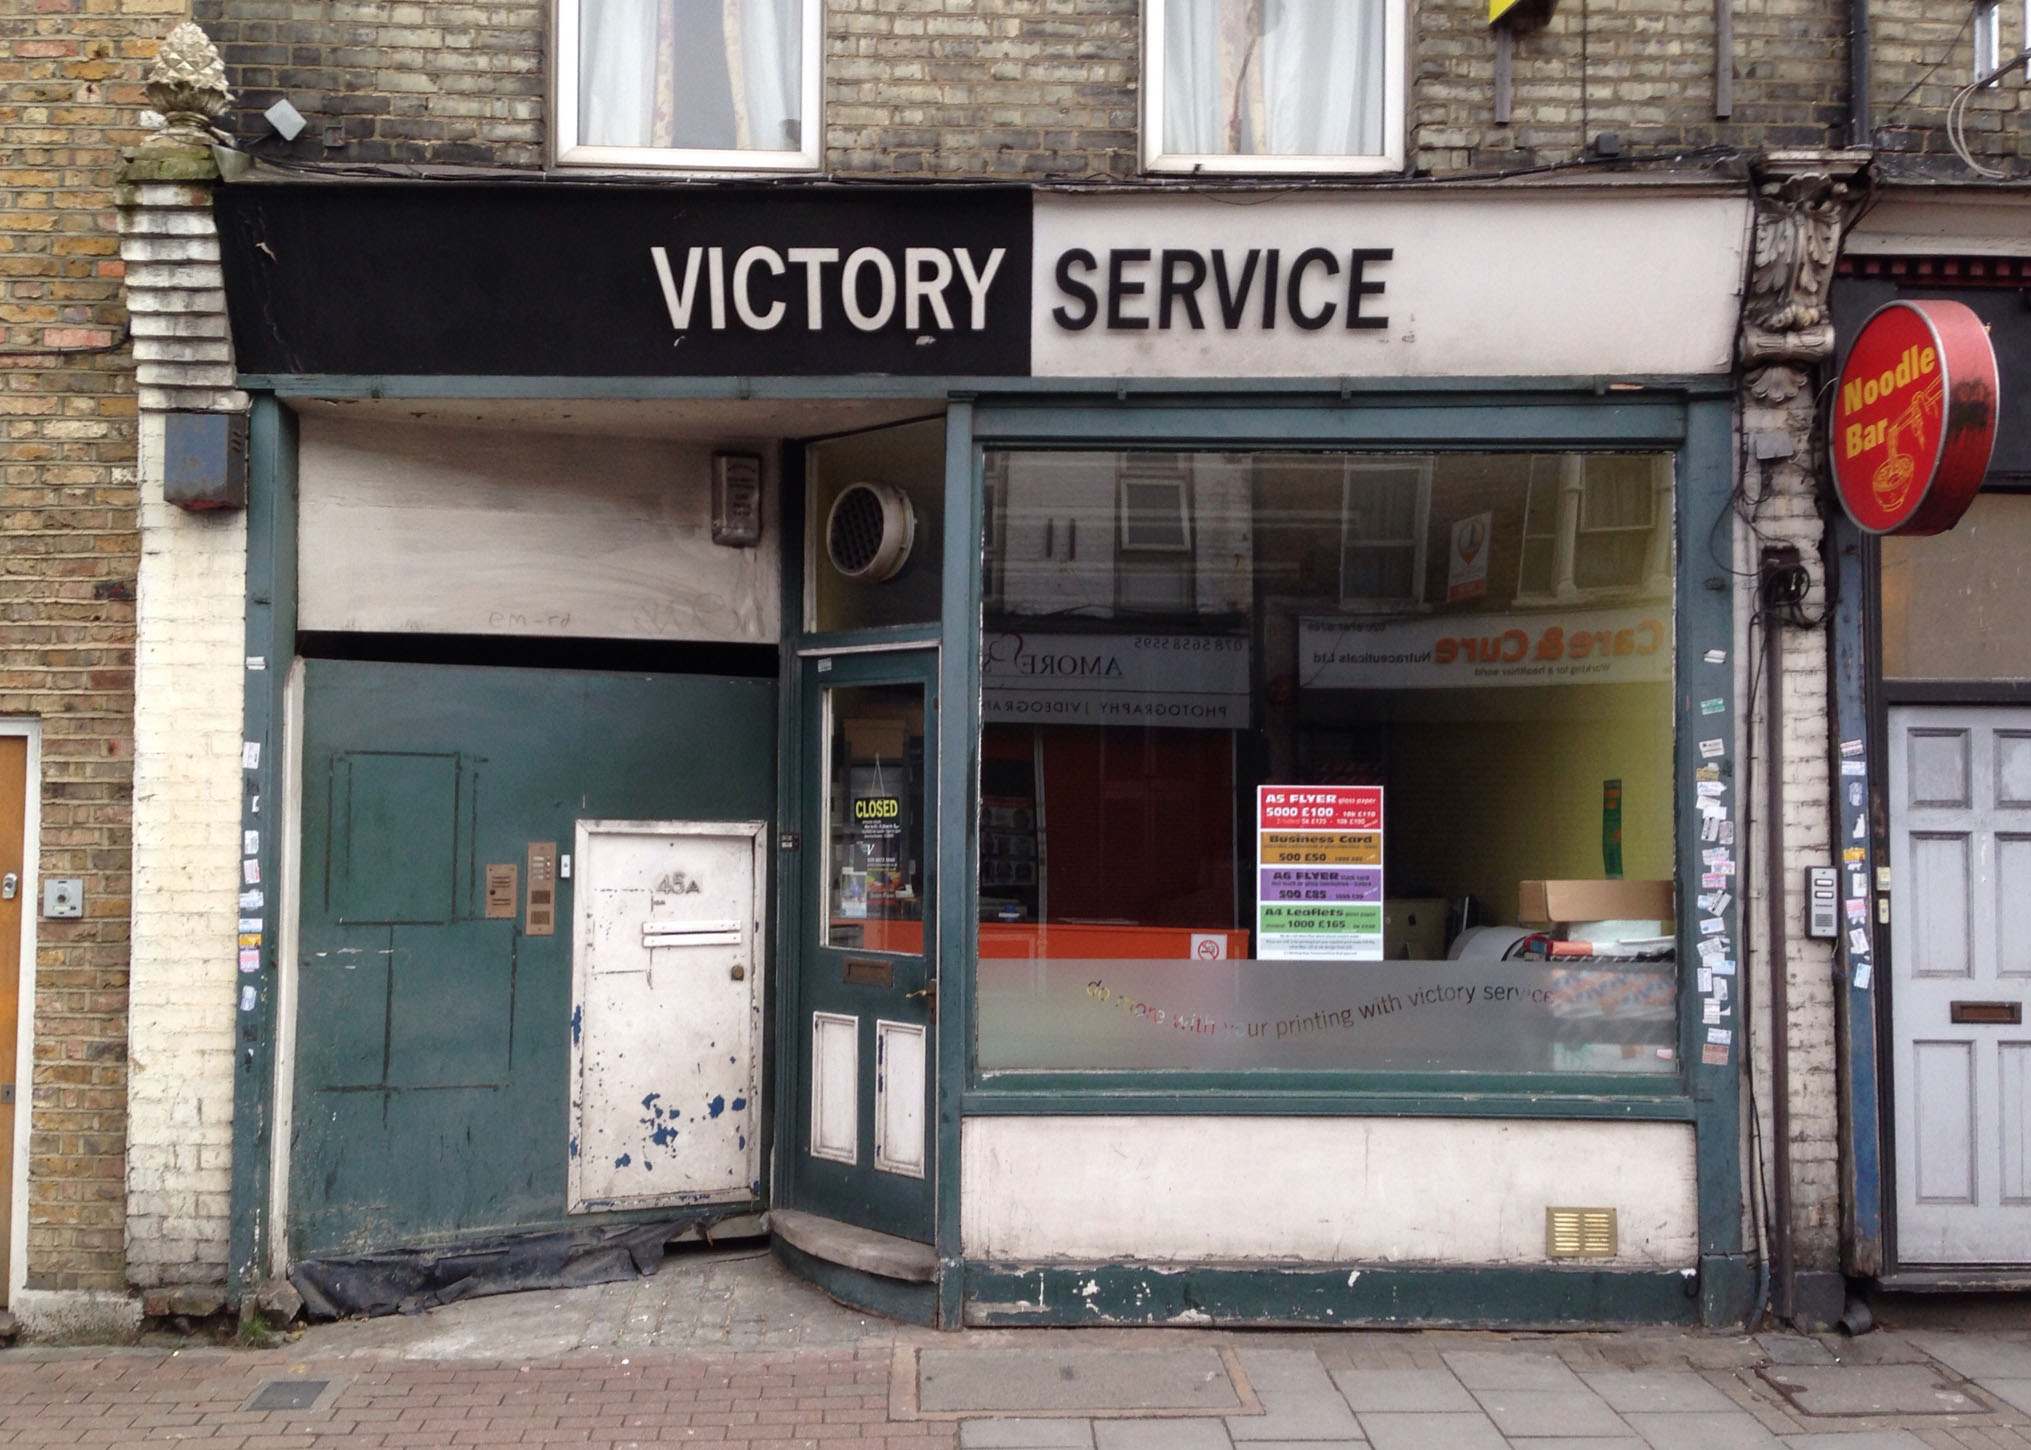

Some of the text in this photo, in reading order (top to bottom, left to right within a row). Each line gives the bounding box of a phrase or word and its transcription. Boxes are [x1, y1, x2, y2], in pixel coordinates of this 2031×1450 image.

[651, 246, 1394, 331] VICTORY SERVICE
[1843, 345, 1935, 416] Noodle
[1846, 418, 1889, 459] Bar
[1265, 794, 1285, 804] A5
[1289, 794, 1337, 804] FLYER
[855, 799, 898, 818] CLOSED
[1266, 807, 1298, 817] 5000
[1301, 807, 1334, 817] £100
[1269, 835, 1373, 843] Business Card
[1279, 853, 1301, 861] 500
[1304, 853, 1327, 861] £50
[1273, 872, 1292, 880] A6
[1296, 872, 1340, 880] FLYER
[1279, 890, 1301, 899] 500
[1304, 890, 1327, 899] £85
[1265, 908, 1282, 917] A4
[1286, 908, 1344, 917] Leaflets
[1288, 920, 1315, 928] 1000
[1318, 920, 1346, 928] £165
[1276, 1008, 1354, 1040] printing
[1358, 994, 1403, 1020] with
[1407, 984, 1476, 1007] victory
